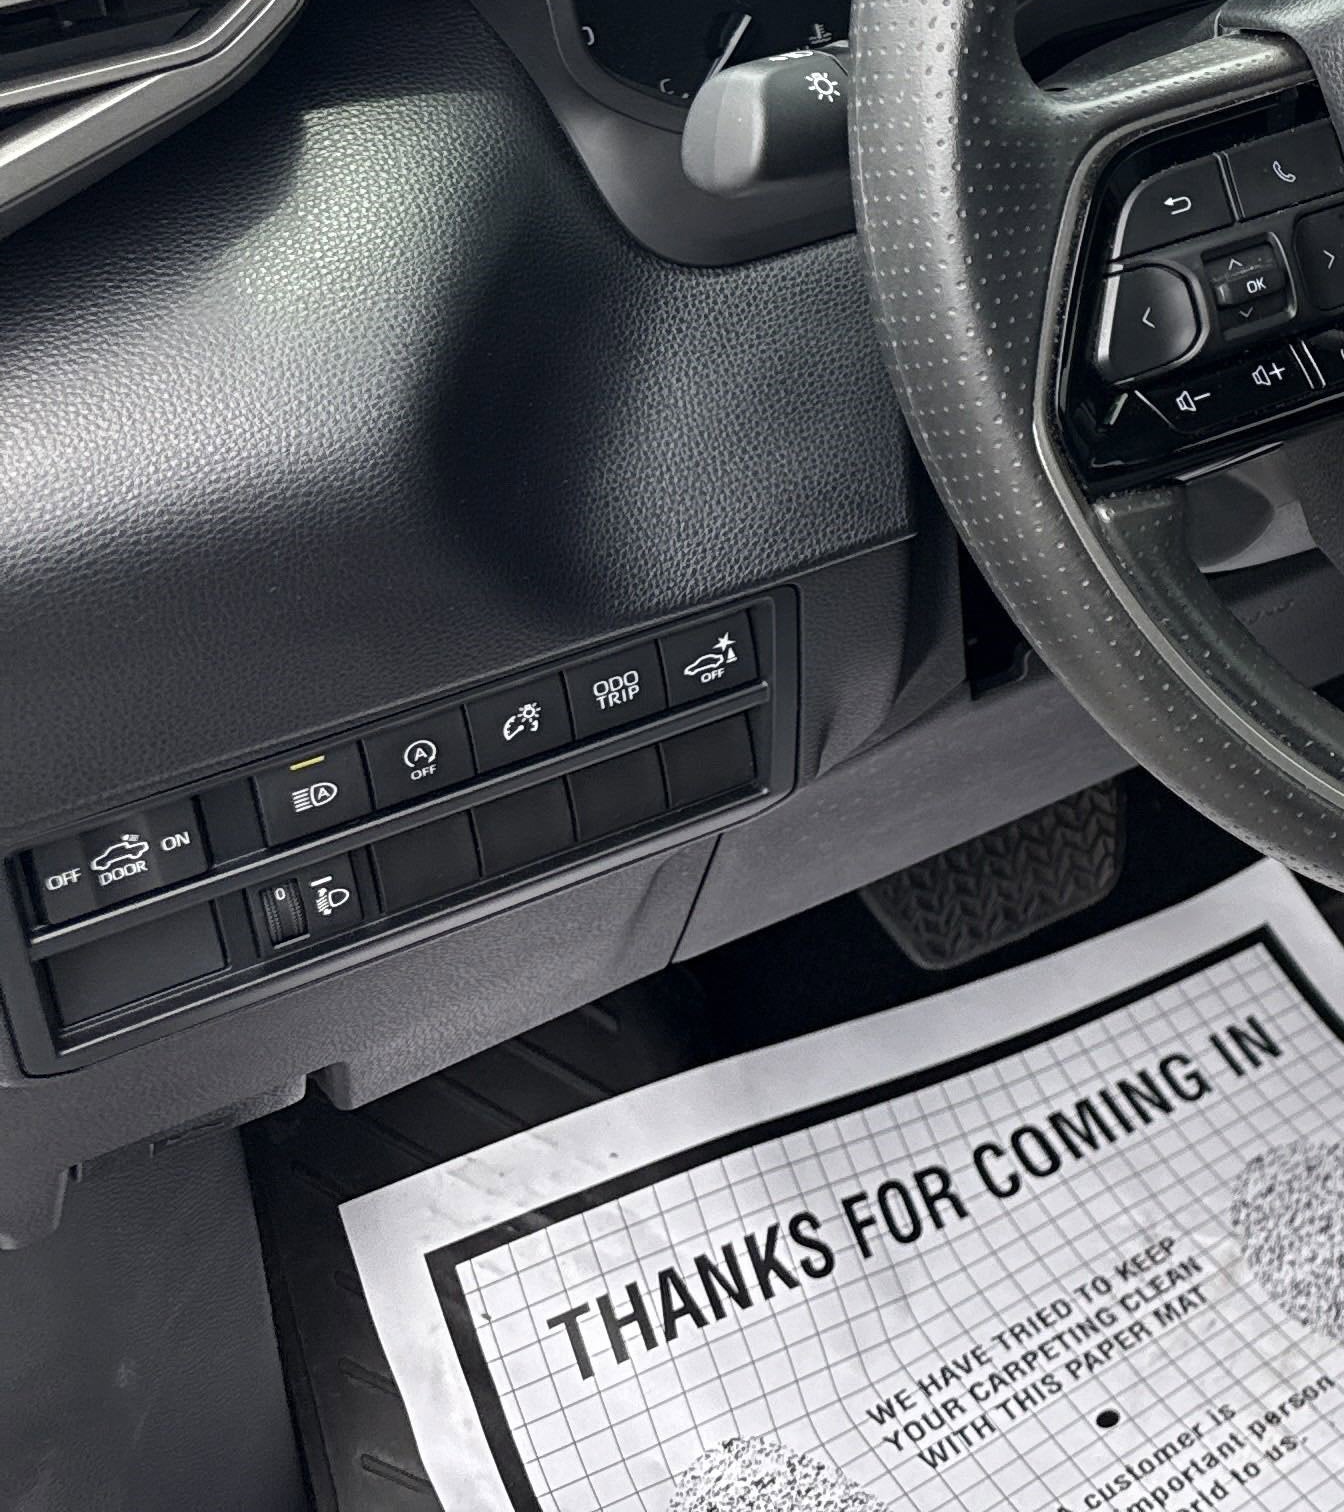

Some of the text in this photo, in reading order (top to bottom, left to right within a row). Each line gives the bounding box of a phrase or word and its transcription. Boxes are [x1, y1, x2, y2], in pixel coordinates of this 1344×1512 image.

[1247, 275, 1266, 294] OK
[592, 670, 640, 697] ODO
[701, 667, 726, 684] OFF
[595, 684, 640, 710] TRIP
[410, 765, 438, 781] OFF
[160, 831, 191, 852] ON
[46, 867, 82, 891] OFF
[99, 859, 148, 886] DOOR
[274, 886, 286, 901] 0
[547, 1013, 1284, 1382] THANKS FOR COMING IN
[865, 1237, 1176, 1426] WE HAVE TRIED TO KEEP
[882, 1256, 1203, 1452] YOUR CARPETING CLEAN
[916, 1284, 1208, 1470] WITH THIS PAPER MAT
[1247, 1373, 1337, 1441] person
[1083, 1403, 1237, 1512] customer is
[1229, 1460, 1262, 1487] to
[1264, 1434, 1309, 1464] us.
